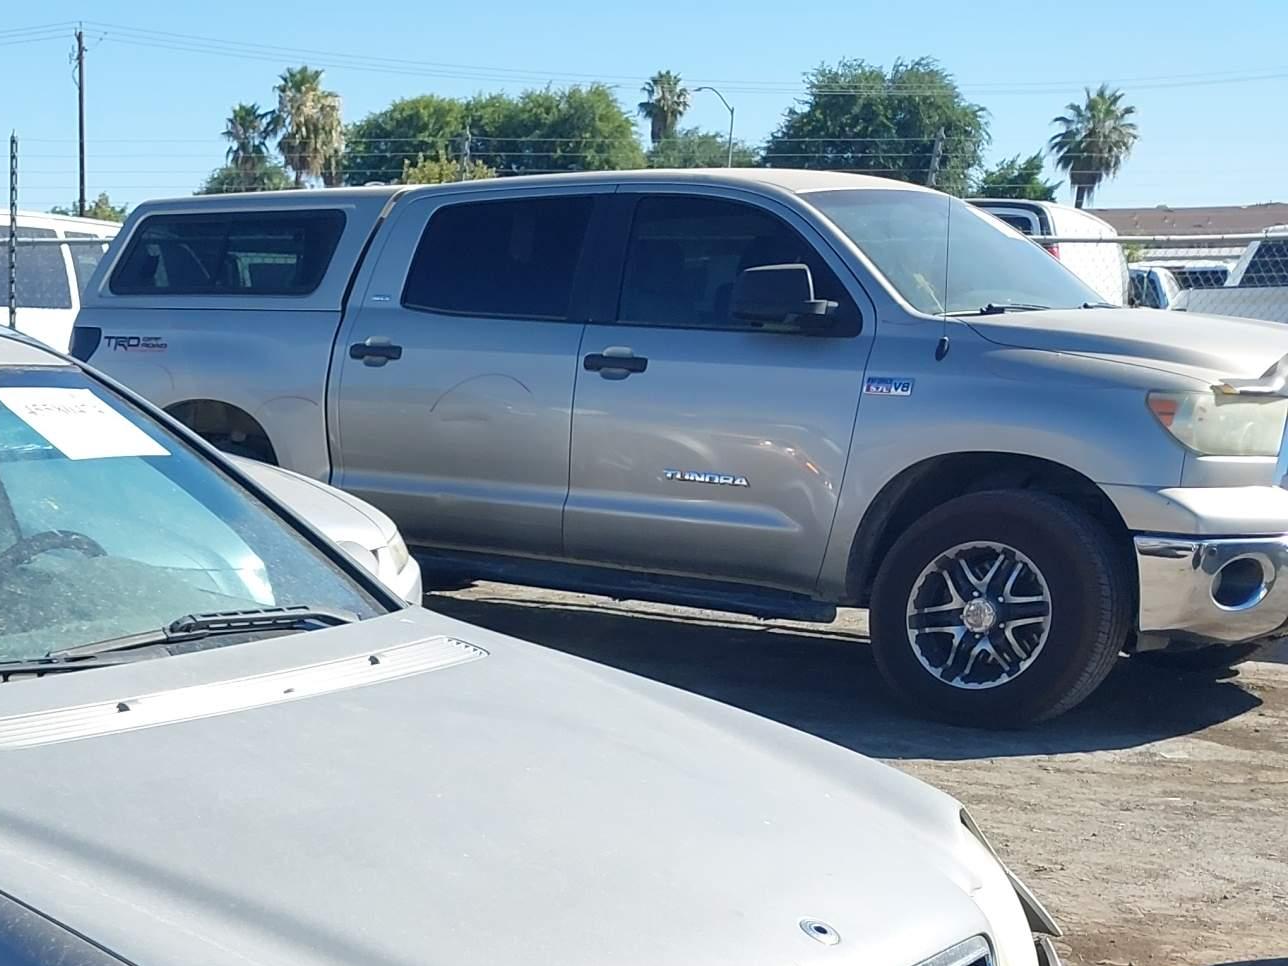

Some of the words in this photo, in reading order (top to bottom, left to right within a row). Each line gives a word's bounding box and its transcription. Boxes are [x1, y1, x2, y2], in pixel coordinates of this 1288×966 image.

[103, 335, 141, 351] TRD
[893, 382, 911, 393] V8
[663, 467, 751, 488] TUNDRA
